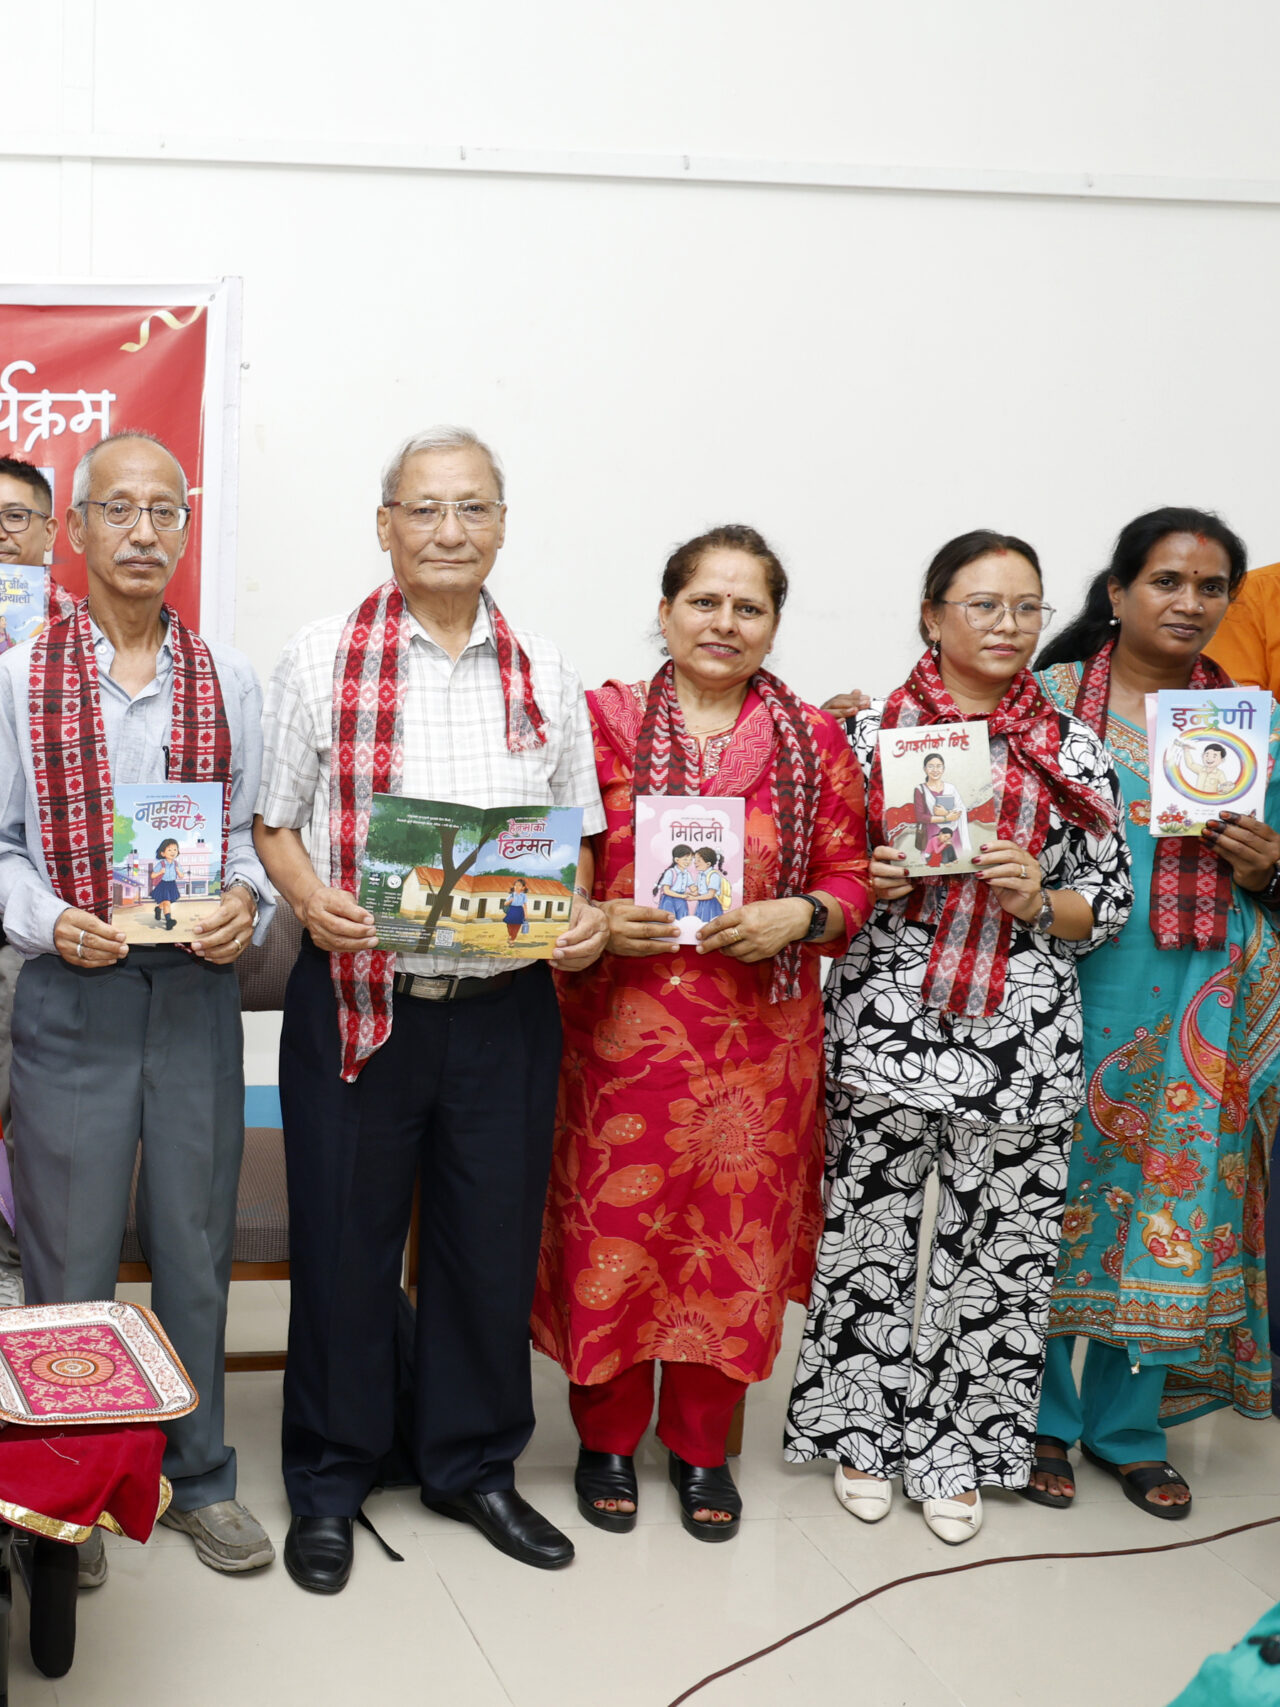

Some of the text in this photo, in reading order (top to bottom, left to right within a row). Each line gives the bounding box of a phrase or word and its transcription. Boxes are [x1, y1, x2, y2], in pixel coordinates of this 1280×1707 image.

[134, 795, 200, 822] नामको
[151, 814, 203, 831] कथा
[669, 821, 724, 843] मितिनी
[497, 831, 555, 861] हिम्मत
